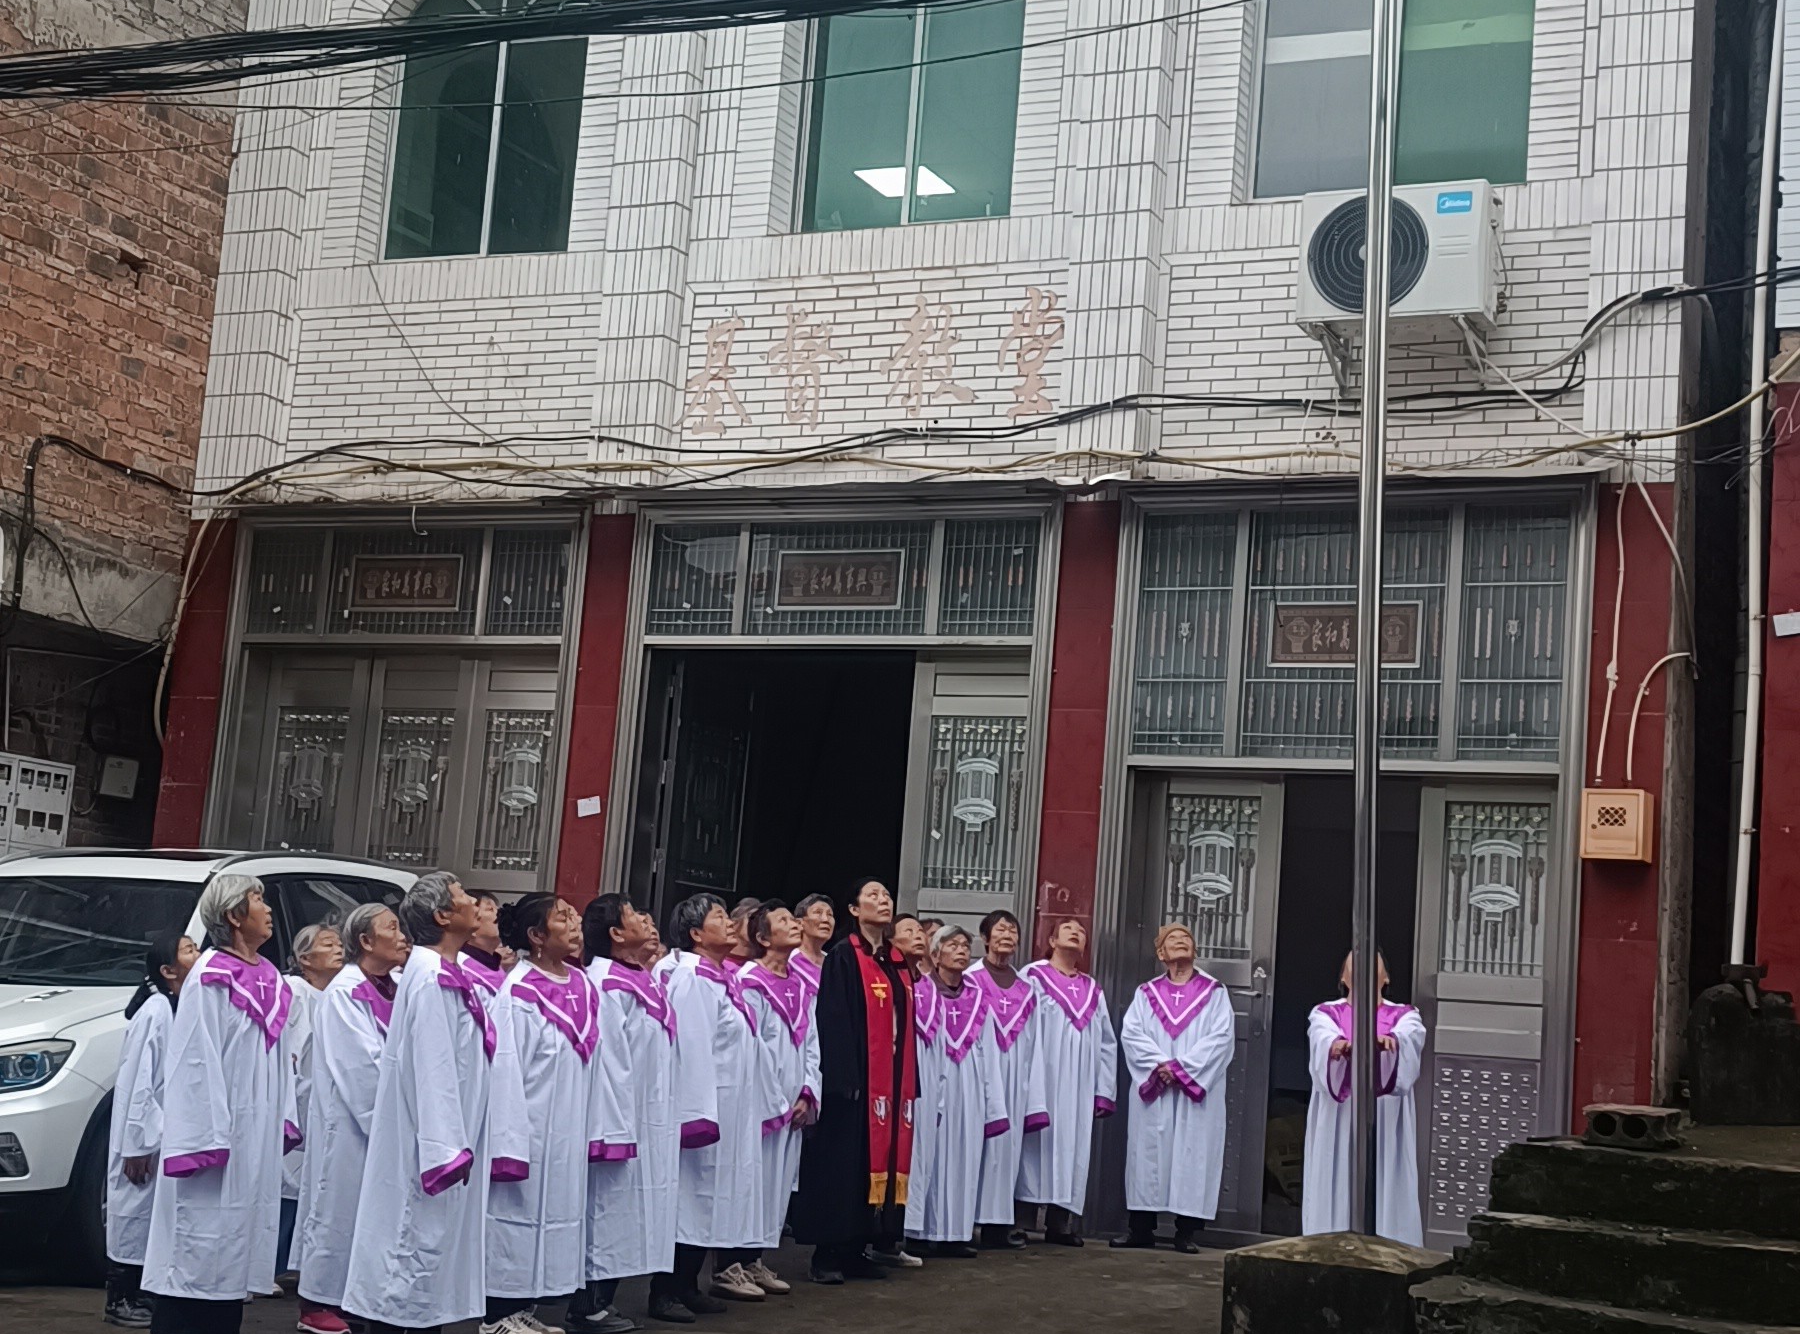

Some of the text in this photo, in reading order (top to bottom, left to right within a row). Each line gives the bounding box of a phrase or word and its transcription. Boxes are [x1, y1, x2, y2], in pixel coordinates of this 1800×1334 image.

[676, 287, 1065, 435] 基督教堂
[1312, 618, 1351, 652] 家和萬
